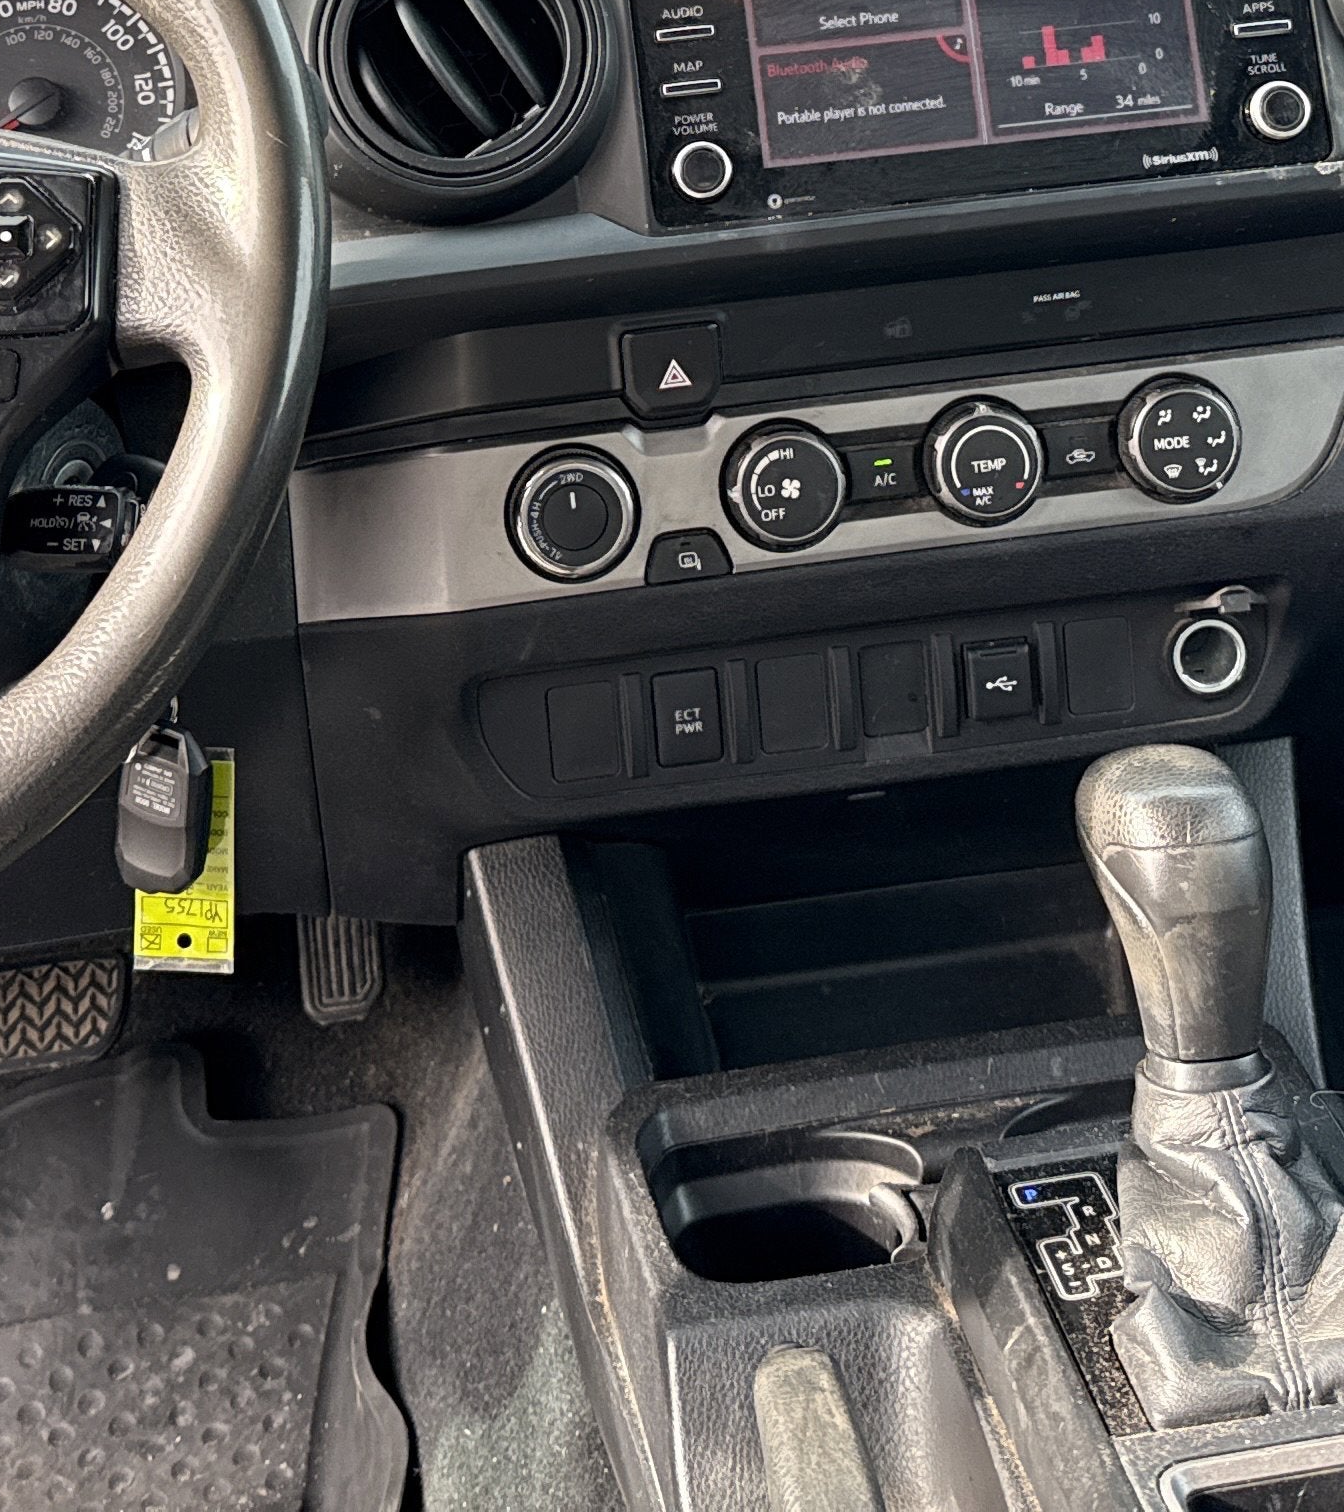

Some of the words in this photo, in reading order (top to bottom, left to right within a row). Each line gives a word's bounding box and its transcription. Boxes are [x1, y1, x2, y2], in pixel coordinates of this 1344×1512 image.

[15, 0, 46, 12] MPH
[661, 5, 704, 20] AUDIO
[1242, 0, 1275, 15] APPS
[17, 14, 47, 24] km/h
[819, 15, 857, 31] Select
[859, 11, 899, 26] Phone
[1147, 12, 1162, 25] 10
[5, 31, 27, 46] 100
[33, 29, 54, 41] 120
[59, 33, 81, 50] 140
[101, 18, 135, 51] 100
[83, 46, 103, 66] 160
[1250, 52, 1279, 65] TUNE
[673, 60, 703, 74] MAP
[767, 59, 828, 78] Bluetooth
[1247, 62, 1287, 76] SCROLL
[99, 67, 115, 88] 180
[1009, 74, 1022, 88] 10
[1024, 75, 1041, 86] min
[1080, 68, 1088, 81] 5
[133, 71, 156, 106] 120
[107, 90, 119, 114] 200
[1044, 101, 1085, 118] Range
[1115, 94, 1134, 109] 34
[1137, 94, 1162, 107] miles
[777, 109, 821, 125] Portable
[824, 106, 856, 123] player
[857, 106, 867, 117] is
[868, 102, 887, 115] not
[889, 95, 947, 114] connected.
[674, 112, 715, 125] POWER
[100, 116, 117, 139] 220
[672, 122, 719, 136] VOLUME
[1153, 436, 1191, 450] MODE
[779, 448, 794, 460] HI
[970, 458, 1007, 474] TEMP
[559, 472, 584, 485] 2WD
[873, 472, 897, 487] A/C
[757, 484, 776, 498] LO
[972, 485, 994, 496] MAX
[68, 494, 94, 507] RES
[975, 495, 993, 506] A/C
[760, 507, 786, 522] OFF
[30, 517, 55, 529] HOLD
[63, 538, 88, 551] SET
[674, 707, 701, 722] ECT
[675, 720, 704, 735] PWR
[140, 925, 163, 934] USED
[1023, 1188, 1038, 1201] P
[1081, 1204, 1097, 1217] R
[1084, 1233, 1102, 1246] N
[1060, 1262, 1076, 1276] S
[1096, 1256, 1113, 1270] D
